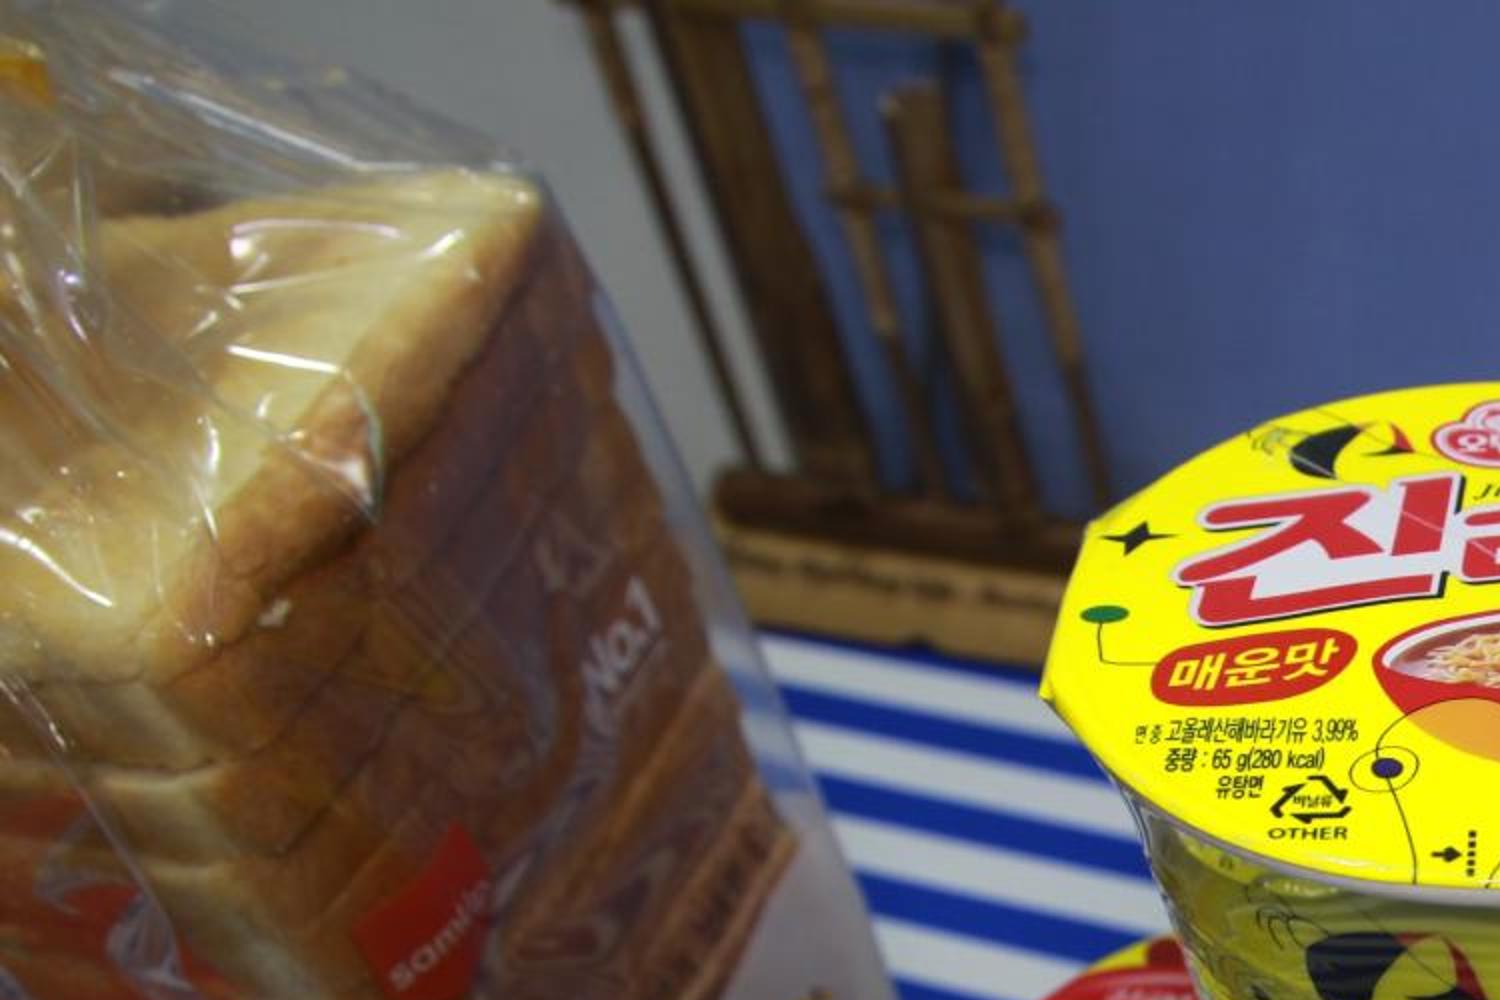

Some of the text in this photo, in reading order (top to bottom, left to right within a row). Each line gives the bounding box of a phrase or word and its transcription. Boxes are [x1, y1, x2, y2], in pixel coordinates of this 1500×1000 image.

[1167, 637, 1340, 690] 매운맛
[1165, 716, 1308, 745] 고올레산해바라기유
[1312, 718, 1359, 743] 3.99%
[1165, 747, 1198, 773] 중량
[1211, 749, 1232, 770] 65
[1287, 747, 1326, 770] kcal)
[1215, 775, 1266, 800] 유탕면
[1267, 826, 1349, 841] OTHER
